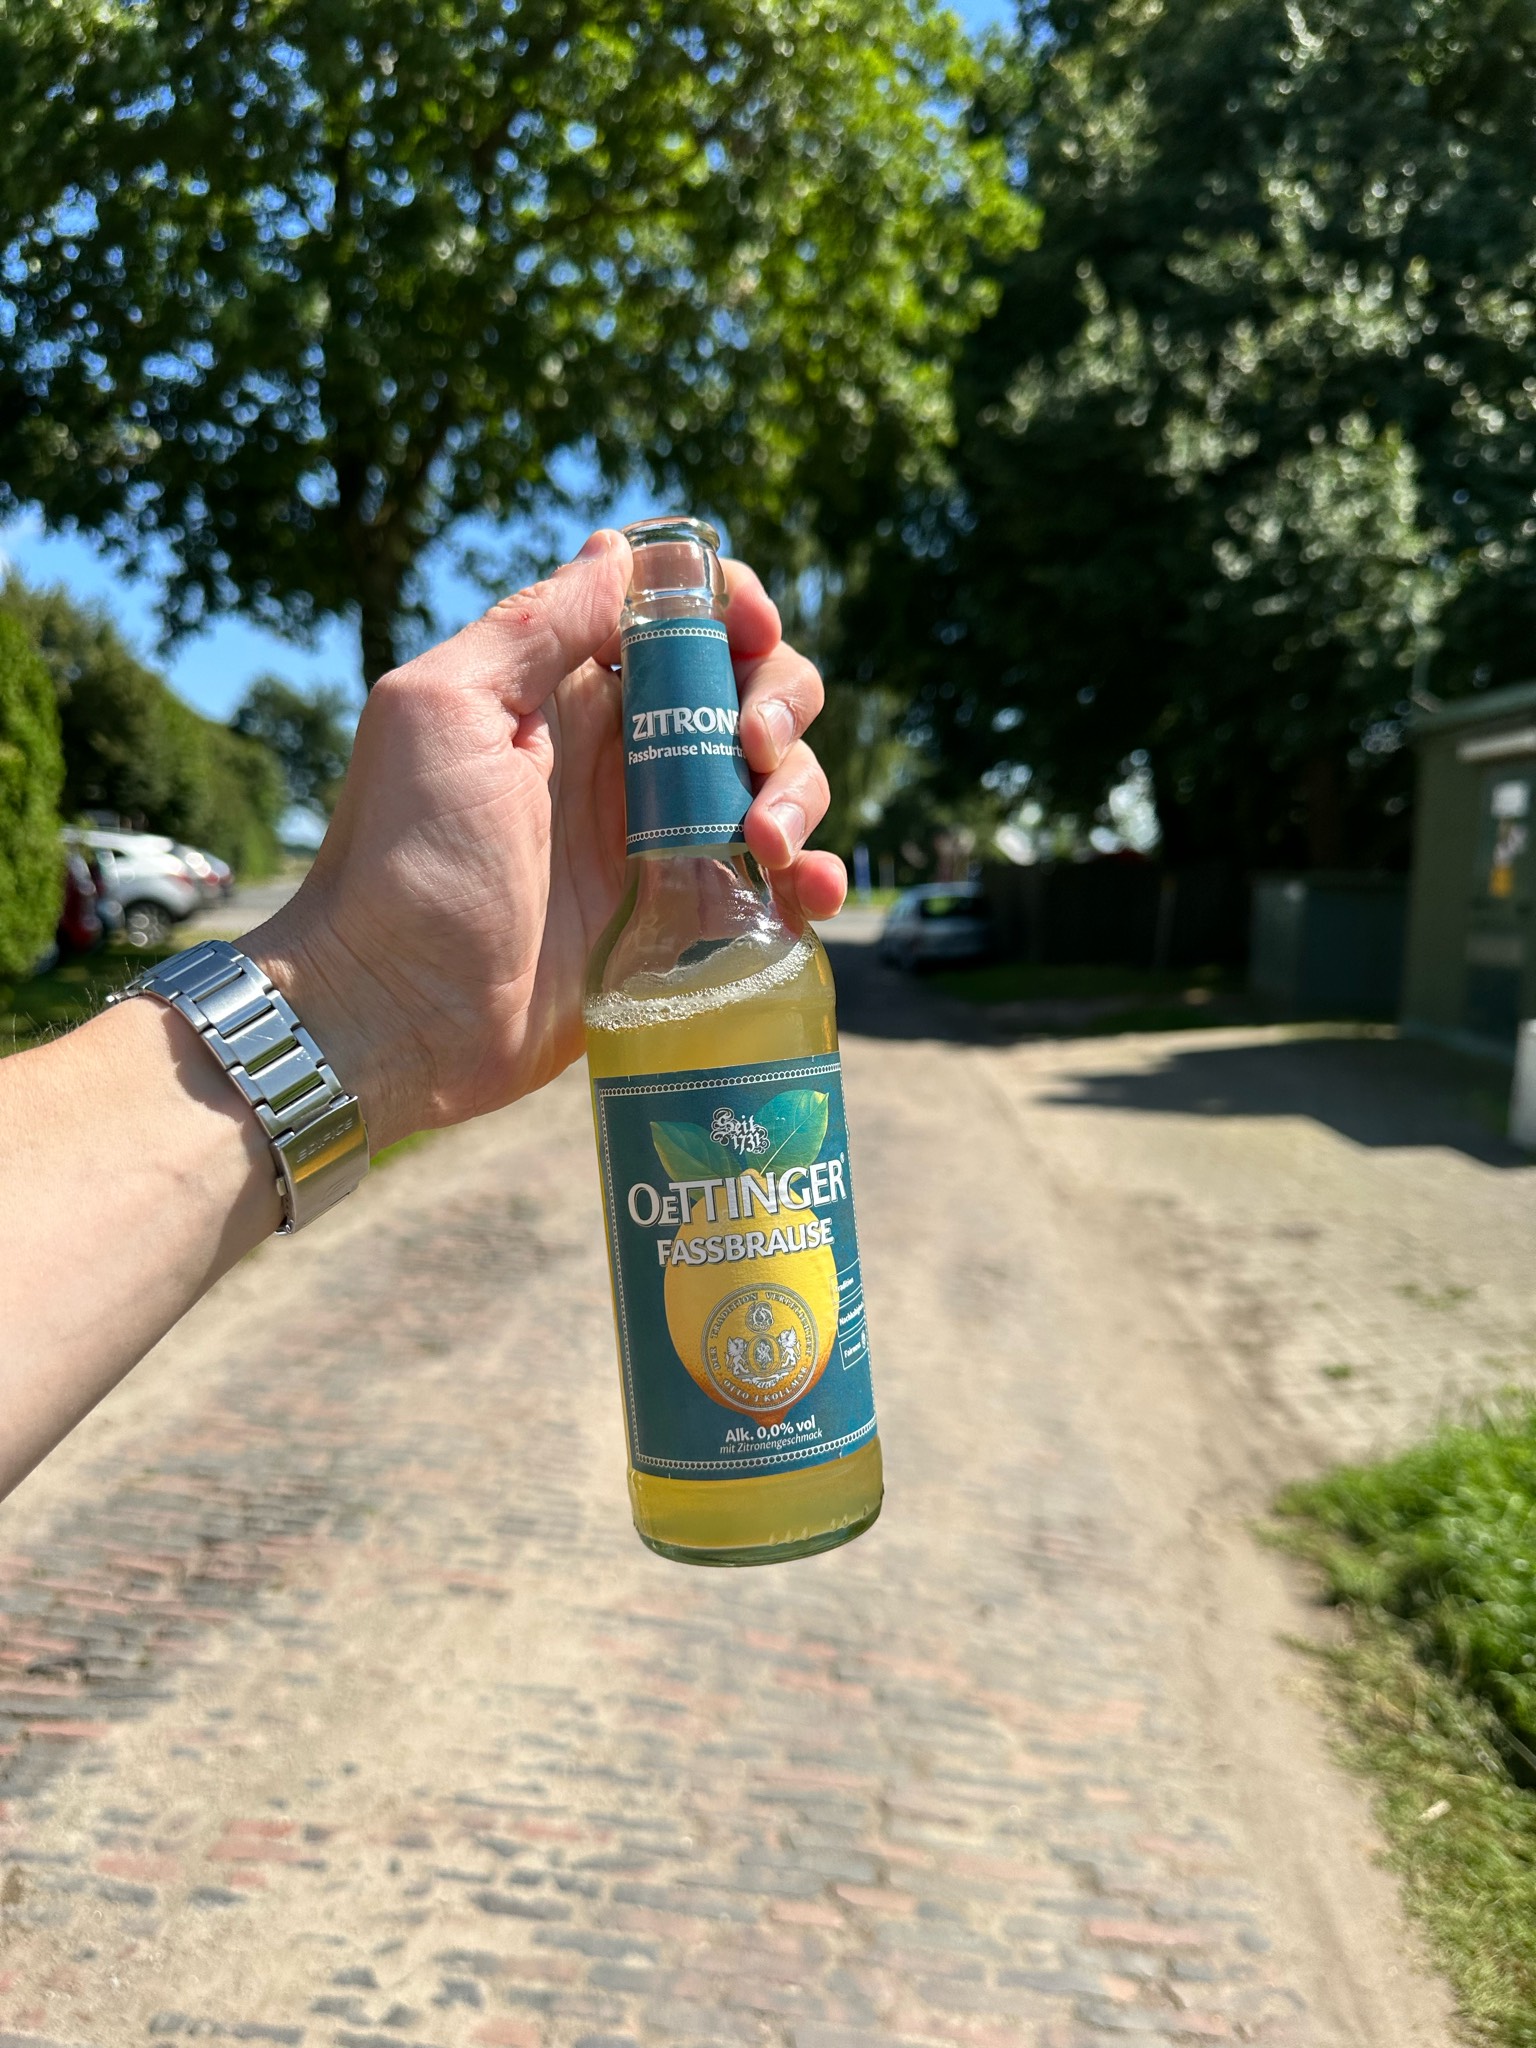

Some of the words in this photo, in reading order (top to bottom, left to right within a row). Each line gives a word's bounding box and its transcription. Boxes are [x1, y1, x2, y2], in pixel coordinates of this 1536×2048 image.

[628, 745, 698, 765] Fassbrause
[297, 1118, 353, 1163] EDIFICE
[710, 1107, 757, 1146] Seit
[731, 1132, 764, 1155] 1731
[657, 1217, 836, 1268] FASSBRAUSE
[710, 1292, 759, 1338] TRADITION
[720, 1443, 736, 1454] mit
[737, 1427, 823, 1454] Zitronengeschmack
[725, 1427, 755, 1442] Alk.
[756, 1421, 795, 1440] 0,0%
[796, 1414, 816, 1432] vol
